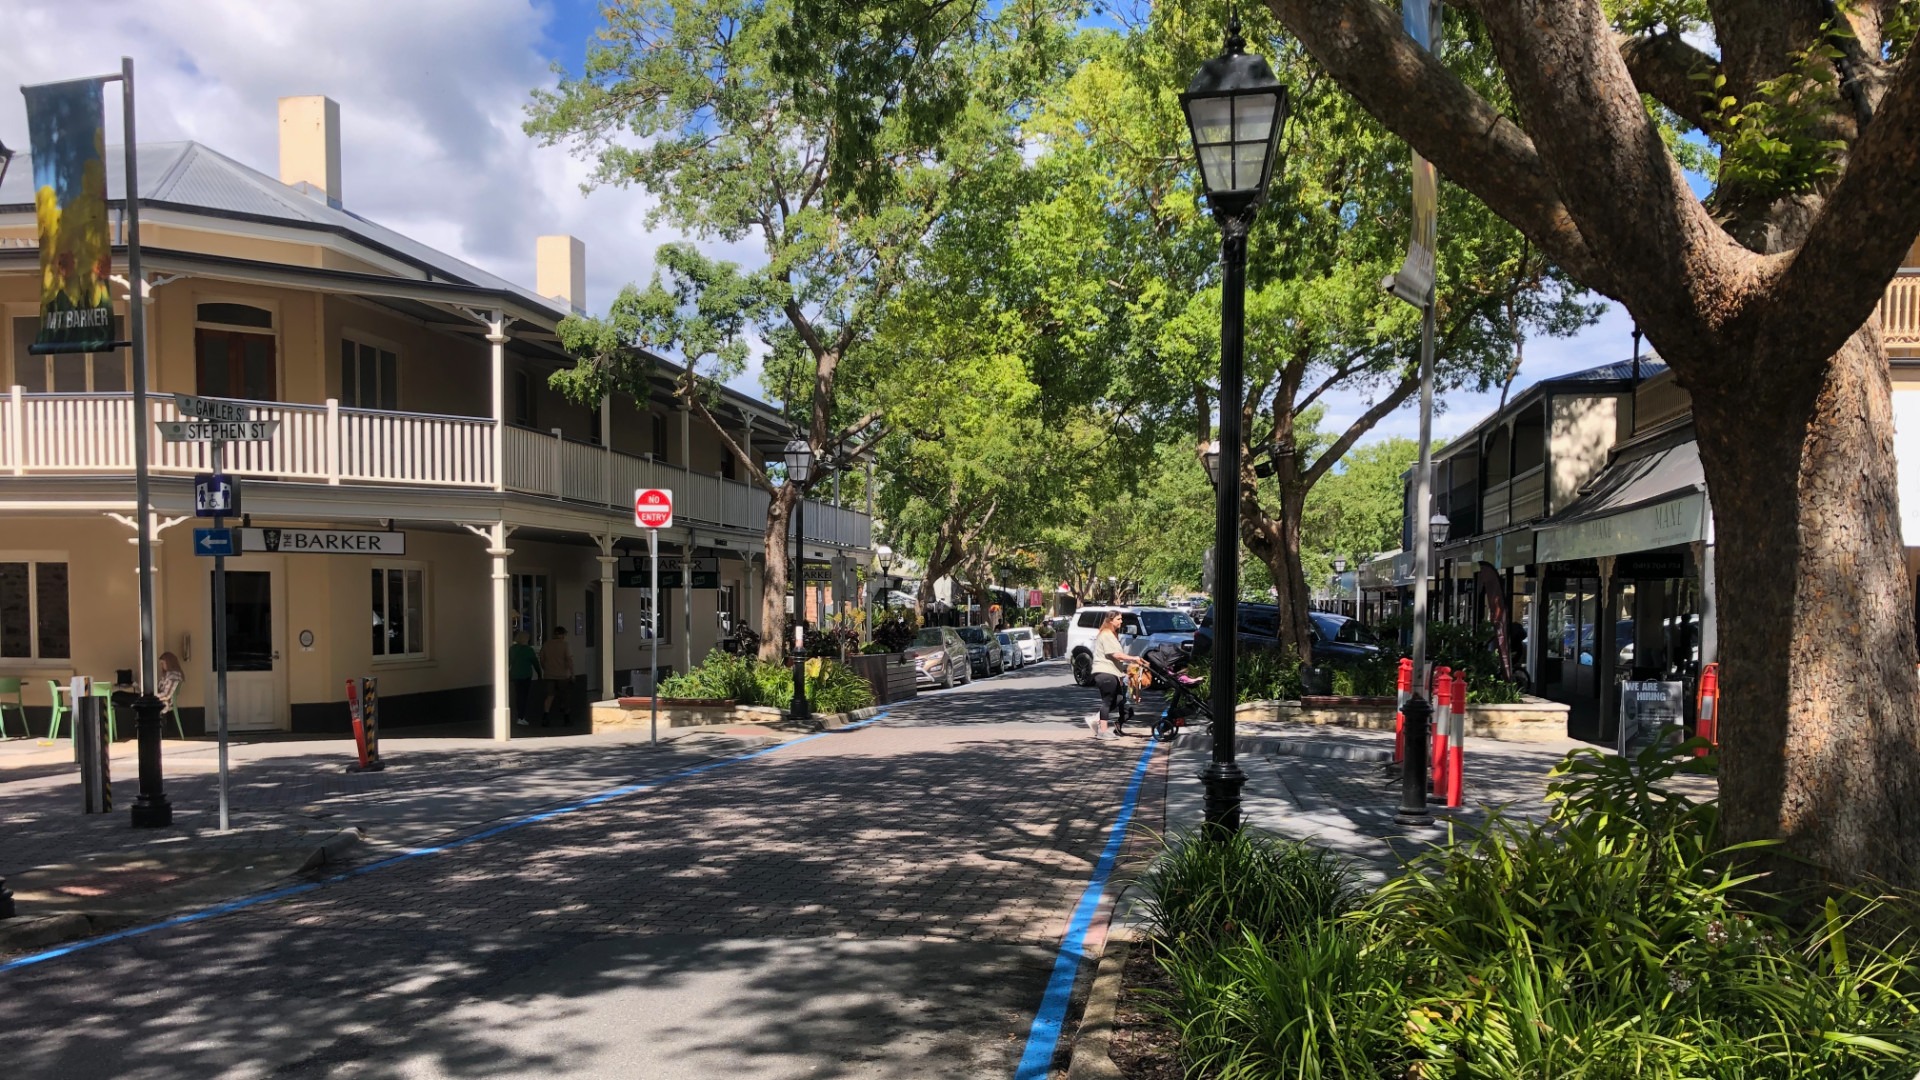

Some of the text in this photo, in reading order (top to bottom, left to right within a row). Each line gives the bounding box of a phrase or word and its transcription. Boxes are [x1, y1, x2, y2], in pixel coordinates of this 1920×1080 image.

[46, 308, 109, 329] MT BARKER
[196, 400, 233, 420] GAWLER
[188, 423, 266, 439] STEPHEN ST
[648, 495, 660, 503] NO
[641, 513, 667, 521] ENTRY
[283, 533, 382, 550] THE BARKER
[1625, 682, 1658, 691] WE ARE
[1636, 692, 1666, 701] HIRING
